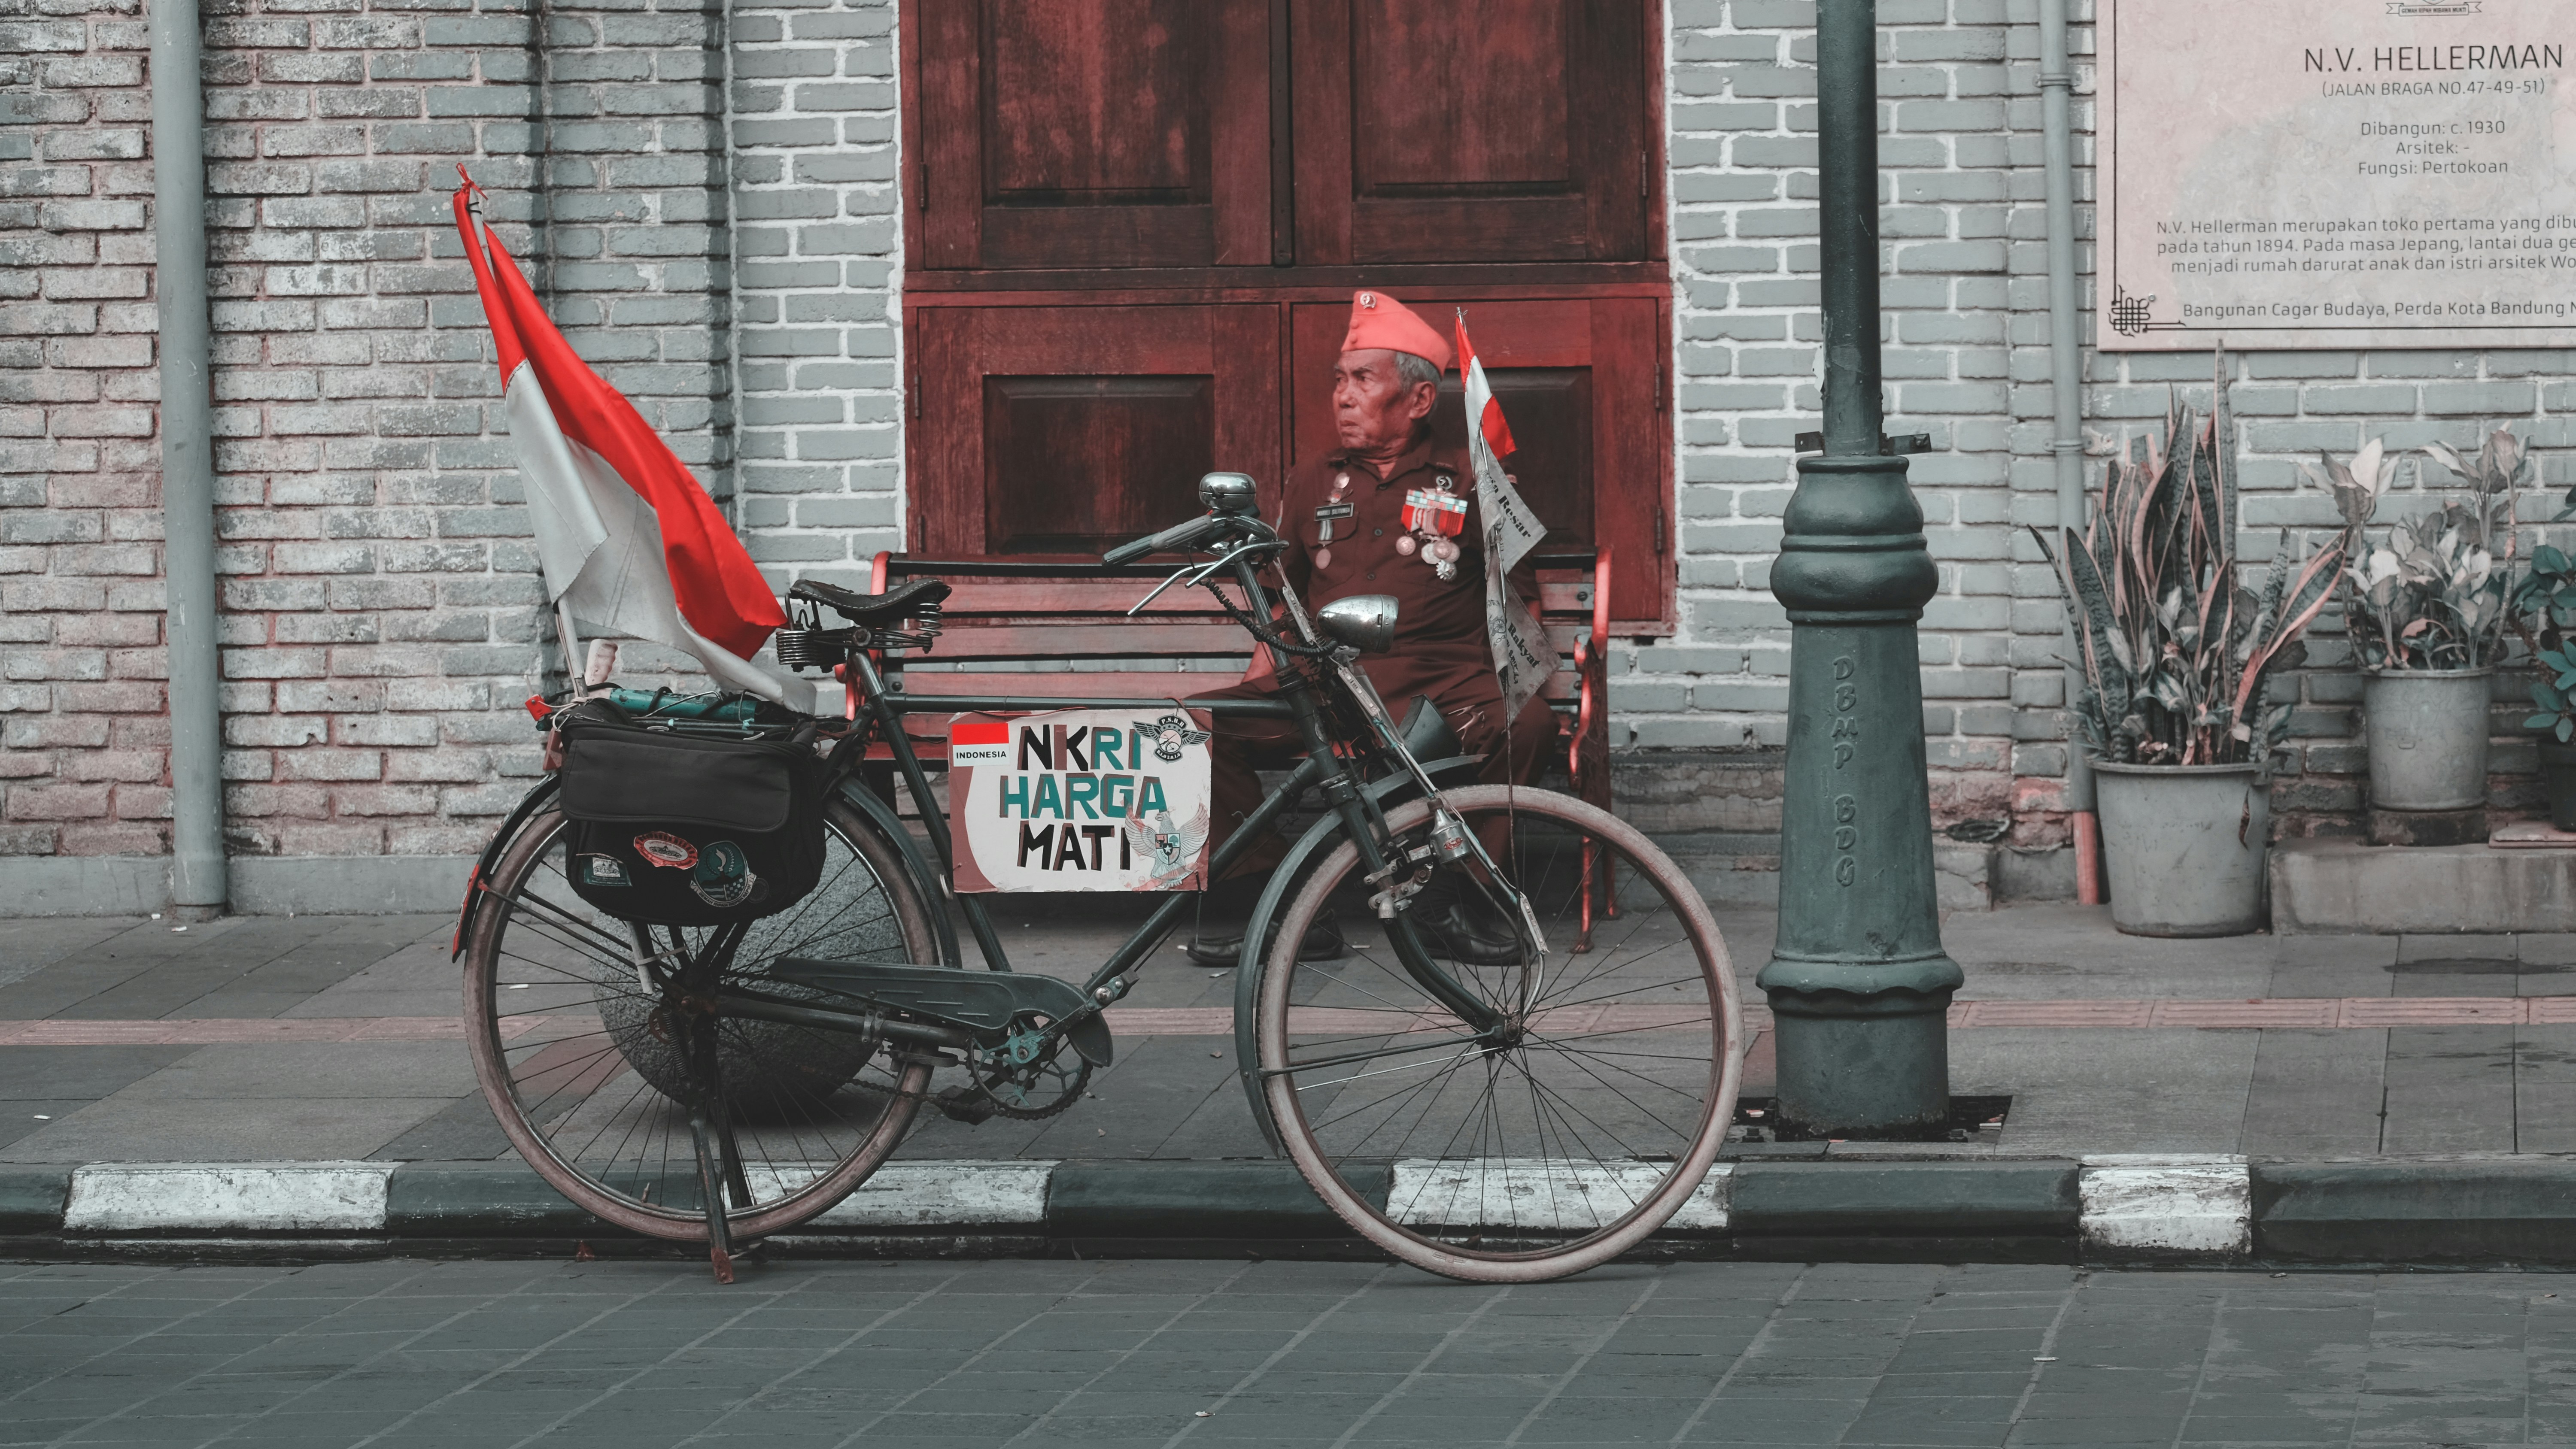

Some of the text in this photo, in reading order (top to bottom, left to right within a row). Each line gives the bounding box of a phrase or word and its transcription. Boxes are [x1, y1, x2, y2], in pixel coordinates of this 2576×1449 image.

[2305, 44, 2563, 73] N.V. HELLERMAN
[2322, 78, 2545, 98] (JALAN BRAGA NO.47-49-51)
[2361, 121, 2506, 138] Dibangun: c. 1930
[2396, 140, 2458, 155] Arsitek:
[2359, 160, 2509, 178] Fungsi: Pertokoan
[2157, 221, 2187, 234] N.V.
[2191, 220, 2277, 233] Hellerman
[2283, 218, 2377, 235] merupakan
[2382, 217, 2418, 231] toko
[2424, 218, 2494, 234] pertama
[2500, 218, 2540, 233] yang
[2157, 240, 2198, 257] pada
[2203, 239, 2251, 253] tahun
[2257, 239, 2298, 252] 1894.
[2303, 238, 2344, 252] Pada
[2350, 240, 2394, 251] masa
[2400, 238, 2463, 254] Jepang,
[2469, 235, 2516, 250] lantai
[2522, 235, 2553, 249] dua
[2172, 259, 2239, 276] menjadi
[2244, 258, 2297, 272] rumah
[2303, 258, 2364, 271] darurat
[2369, 257, 2409, 270] anak
[2415, 257, 2445, 270] dan
[2451, 255, 2482, 270] istri
[2488, 255, 2546, 269] arsitek
[2183, 304, 2267, 320] Bangunan
[2272, 302, 2319, 319] Cagar
[2324, 302, 2389, 319] Budaya,
[2395, 301, 2442, 315] Perda
[2448, 302, 2485, 315] Kota
[2491, 300, 2564, 318] Bandung
[1507, 622, 1541, 668] Rakyat
[956, 751, 1007, 759] INDONESIA
[1018, 724, 1141, 771] NKRI
[999, 773, 1167, 819] HARGA
[1017, 821, 1131, 871] MATI
[1834, 794, 1857, 887] BDG
